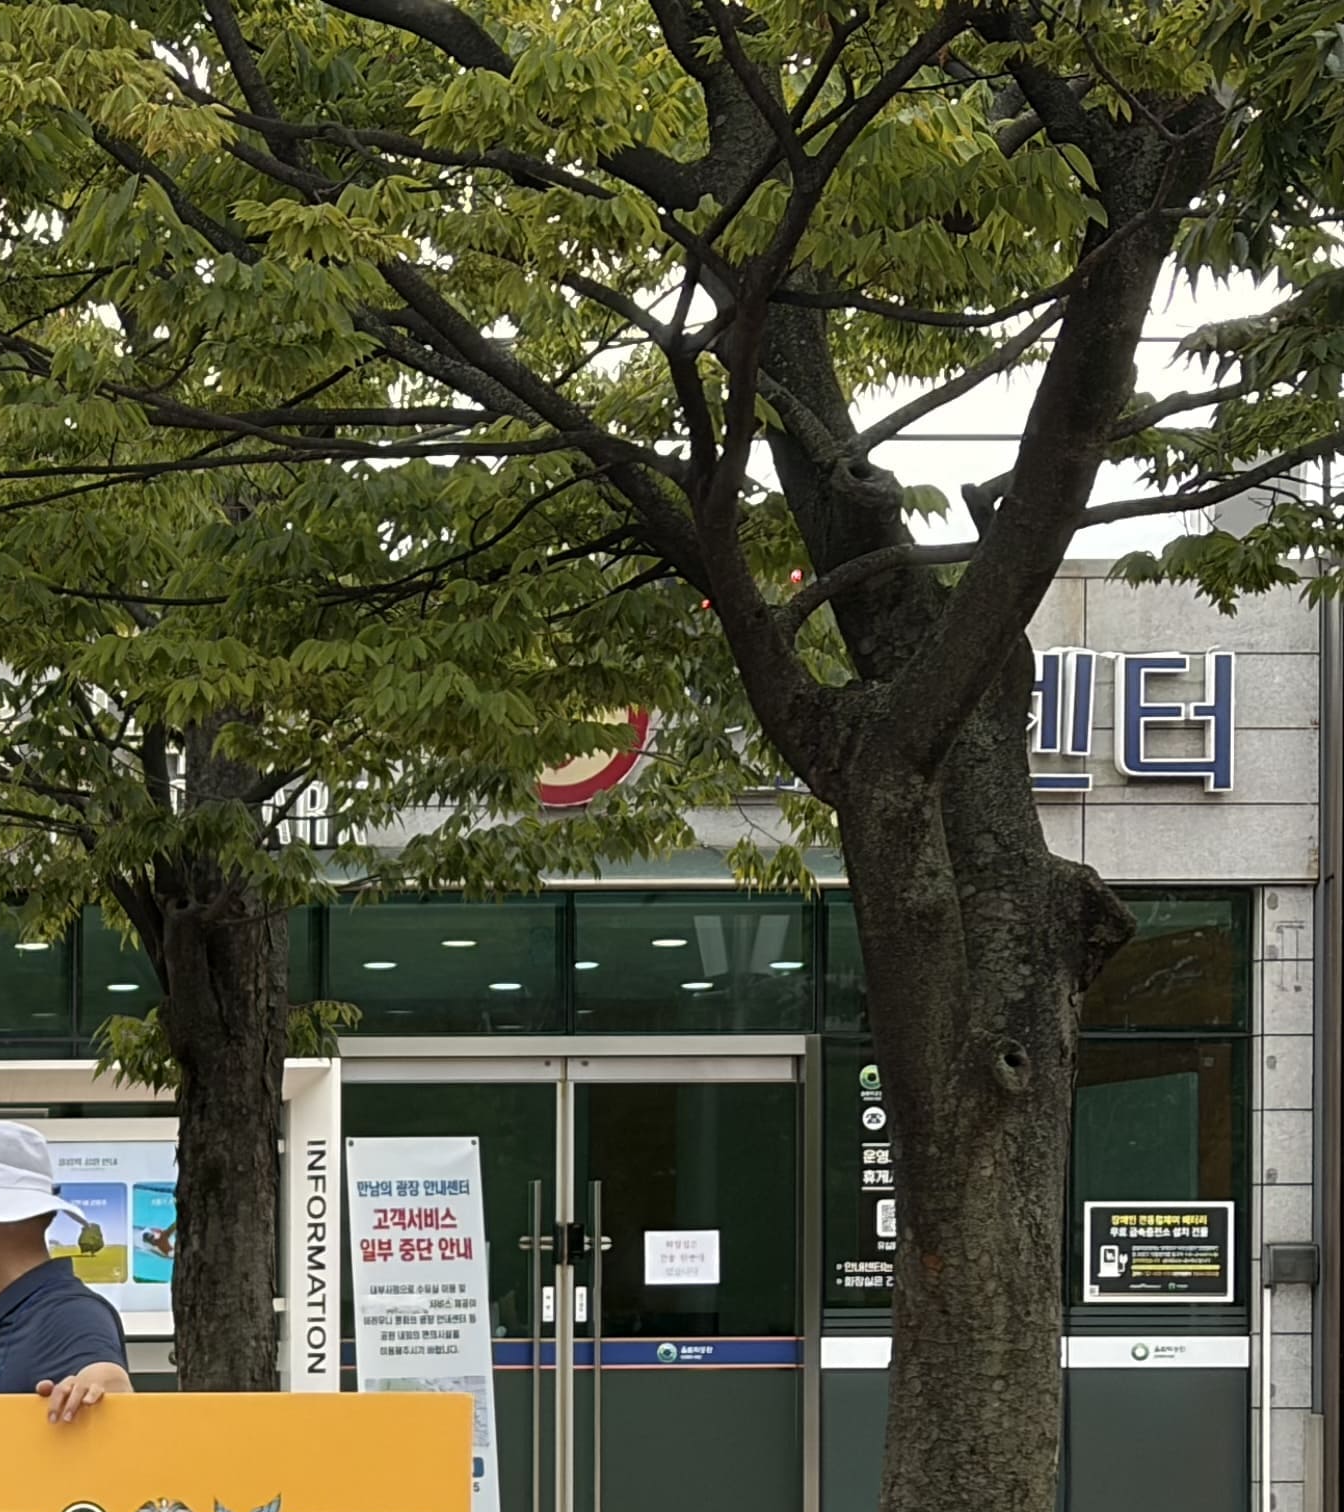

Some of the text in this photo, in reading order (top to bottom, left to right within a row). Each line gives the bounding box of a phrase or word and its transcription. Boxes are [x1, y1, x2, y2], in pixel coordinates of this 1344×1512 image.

[863, 1149, 893, 1164] 운영
[863, 1169, 893, 1185] 휴게
[357, 1179, 471, 1198] 만남의 광장 안내센터
[372, 1207, 458, 1231] 고객서비스
[306, 1140, 327, 1375] INFORMATION
[360, 1236, 474, 1263] 일부 중단 안내
